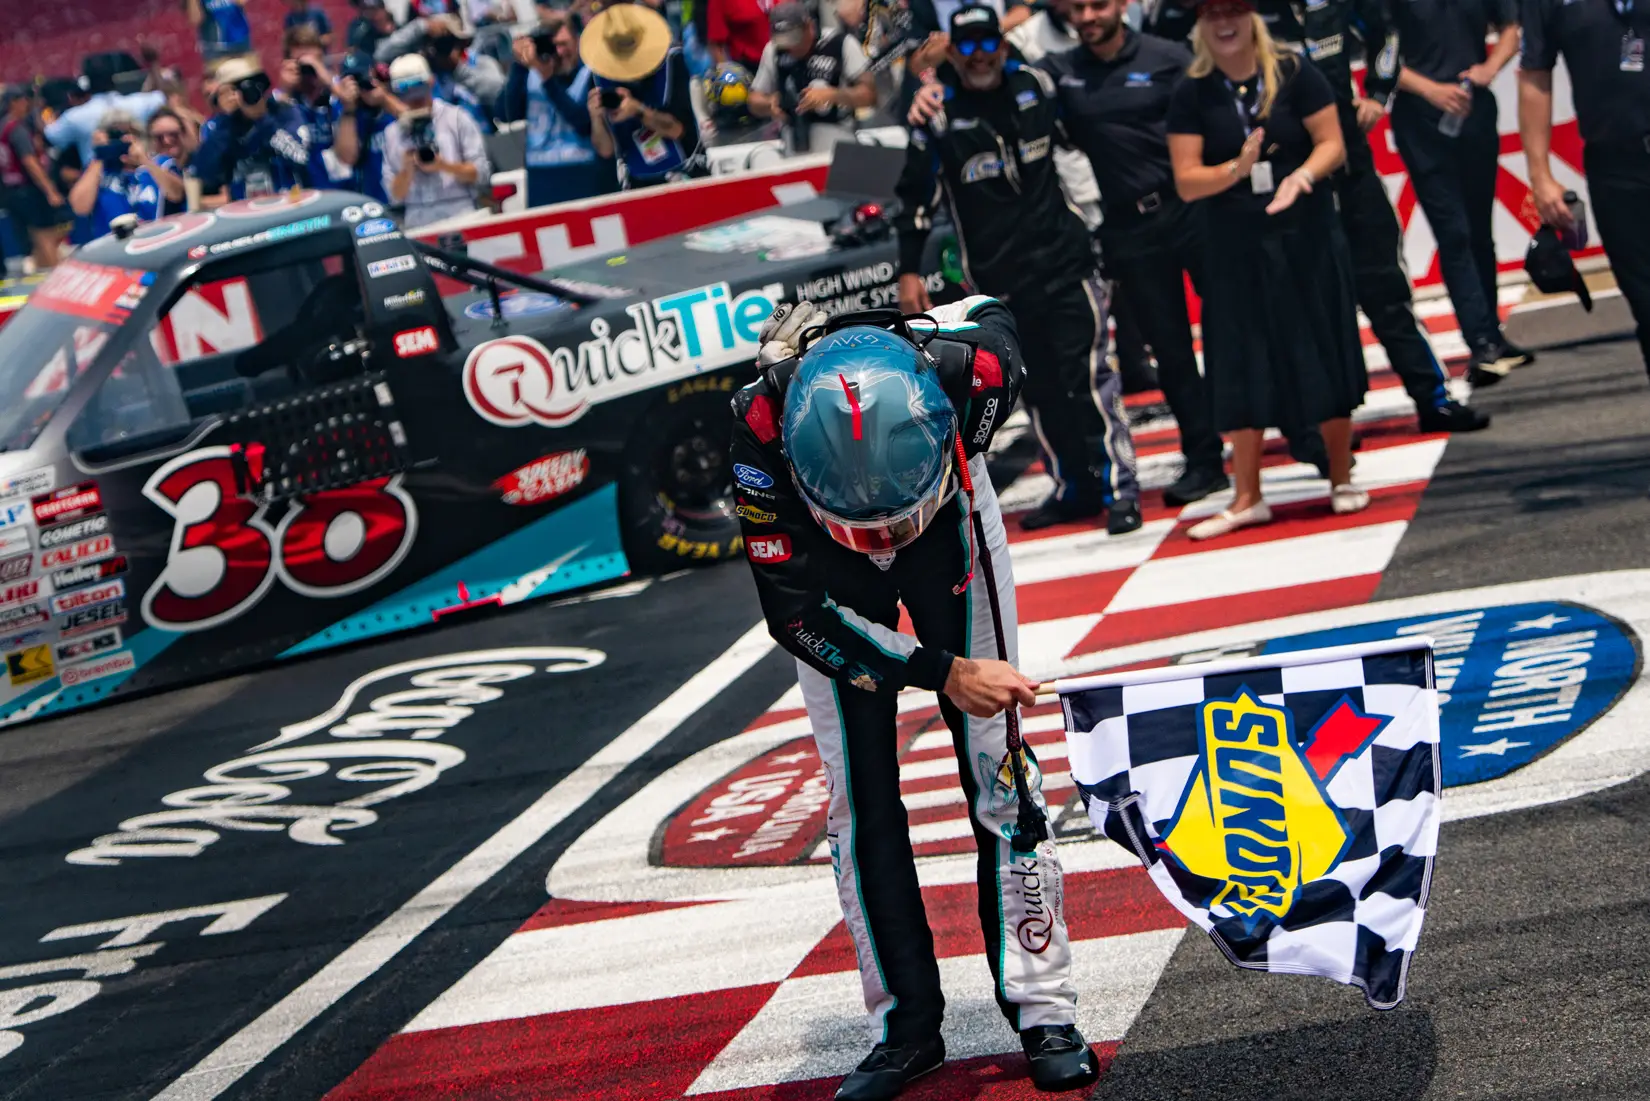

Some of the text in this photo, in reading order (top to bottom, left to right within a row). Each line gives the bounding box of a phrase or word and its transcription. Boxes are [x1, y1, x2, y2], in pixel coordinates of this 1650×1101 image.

[795, 261, 894, 301] HIGH WIND
[395, 327, 438, 357] SEM
[467, 286, 776, 421] QuickTie
[667, 376, 734, 404] EAGLE
[972, 398, 999, 445] sparco
[738, 466, 765, 486] Ford
[737, 505, 775, 522] SUNOCO
[41, 516, 108, 545] COMETIC
[41, 535, 111, 568] CALICO
[750, 539, 785, 559] SEM
[57, 585, 121, 611] tilton
[60, 603, 125, 631] JESEL
[1472, 630, 1598, 734] NORTH
[64, 646, 606, 866] Coca-Cola
